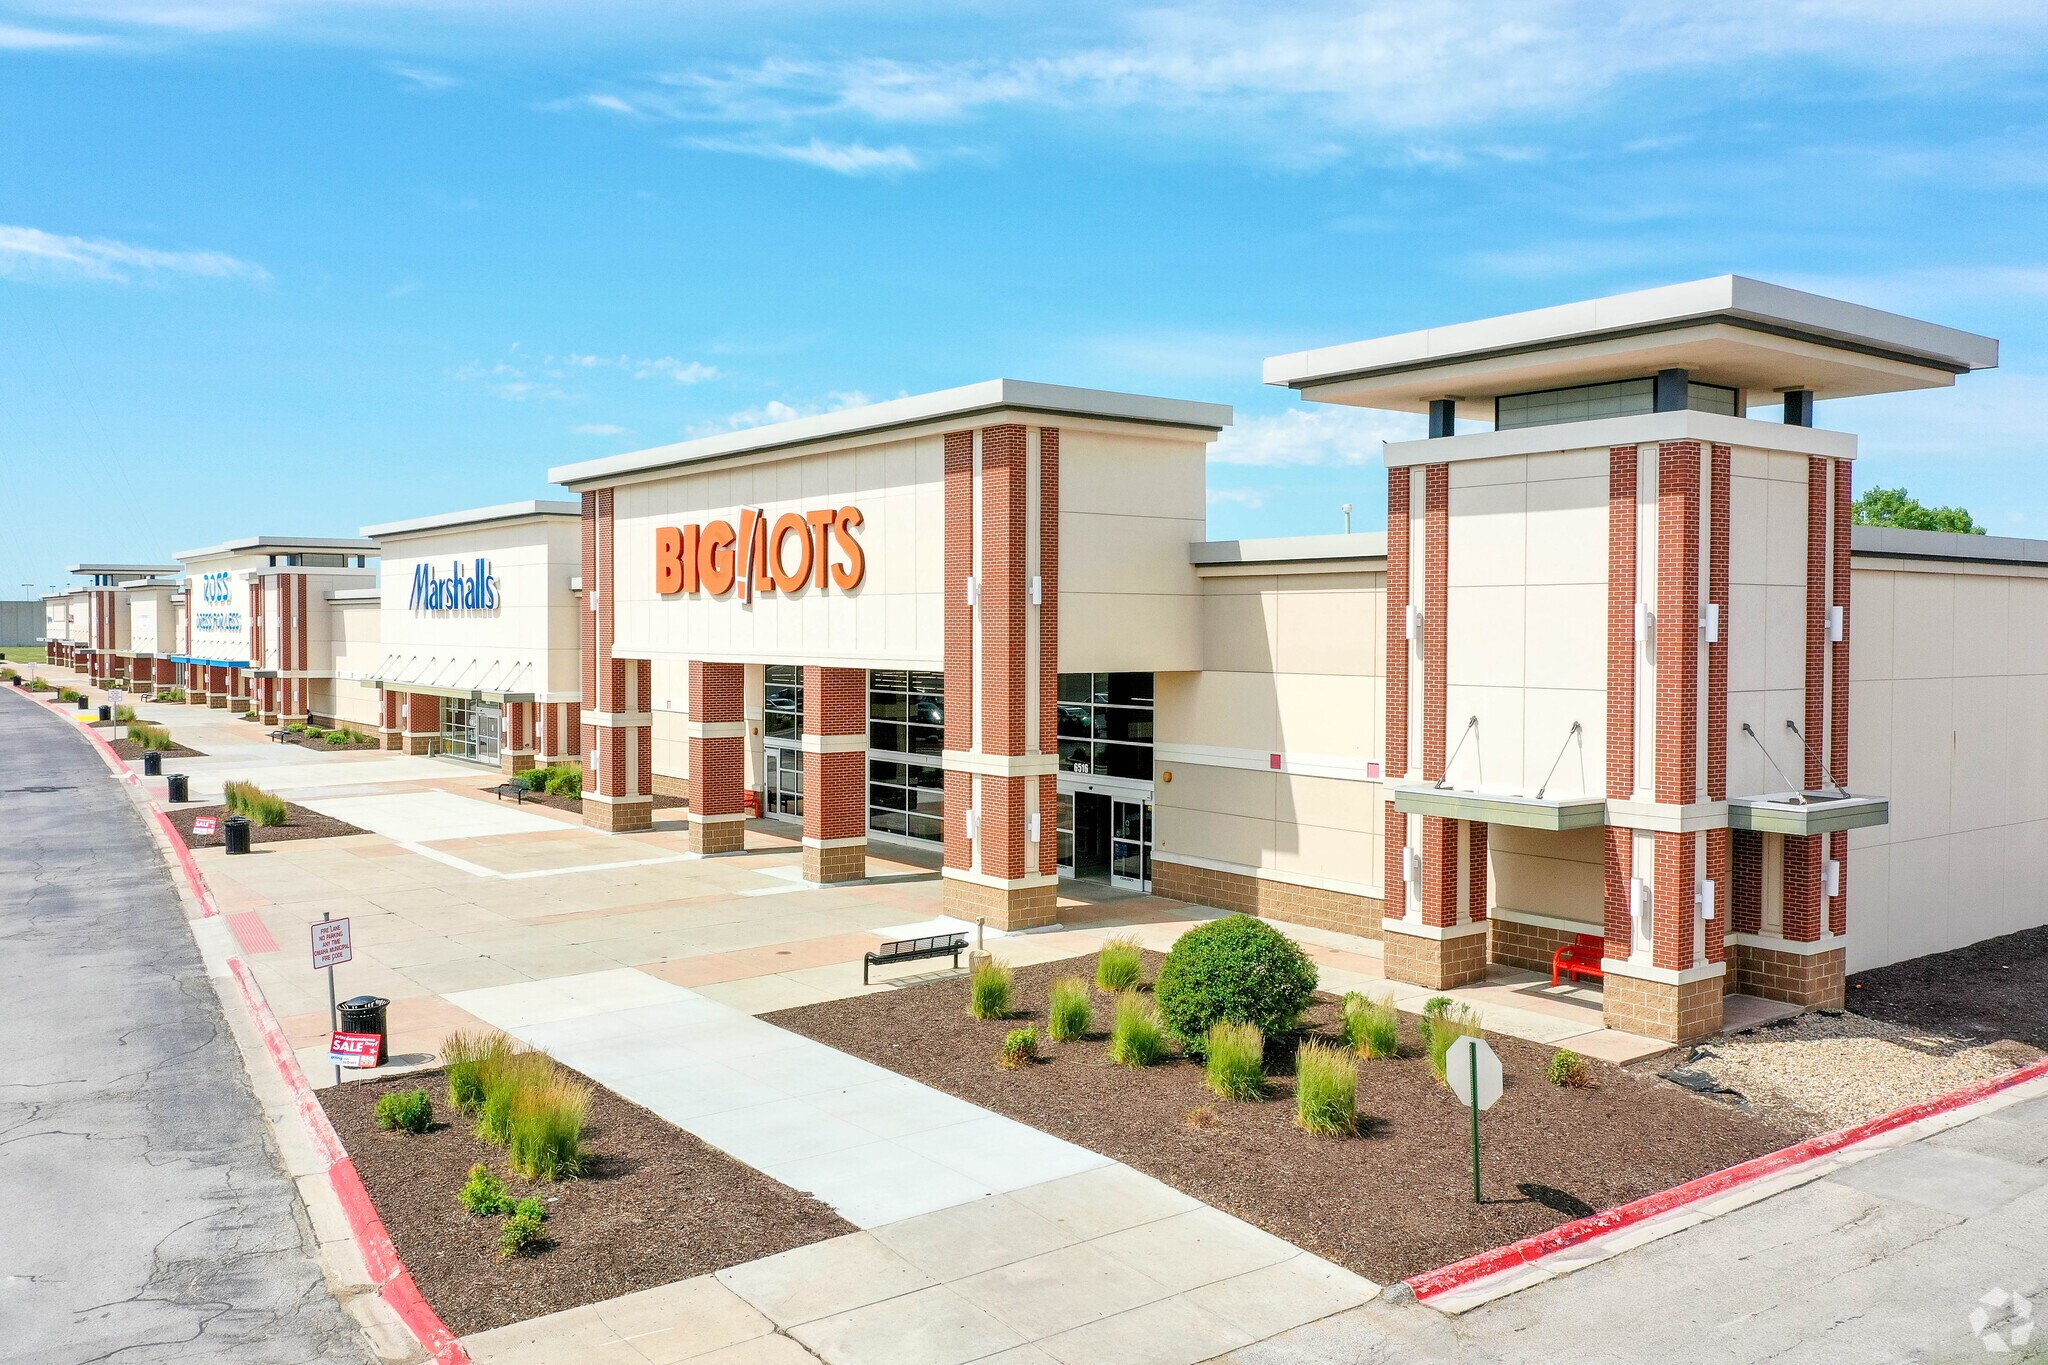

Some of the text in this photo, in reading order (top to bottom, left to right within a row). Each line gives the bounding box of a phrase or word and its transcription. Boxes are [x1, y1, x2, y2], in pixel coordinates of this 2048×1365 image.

[754, 505, 866, 593] LOTS
[203, 571, 230, 602] ROSS
[408, 557, 496, 611] Marshalls
[326, 931, 343, 939] PARKING
[314, 943, 350, 957] OMAHA MUNICIPAL
[332, 952, 343, 960] CODE
[332, 1039, 364, 1053] SALE
